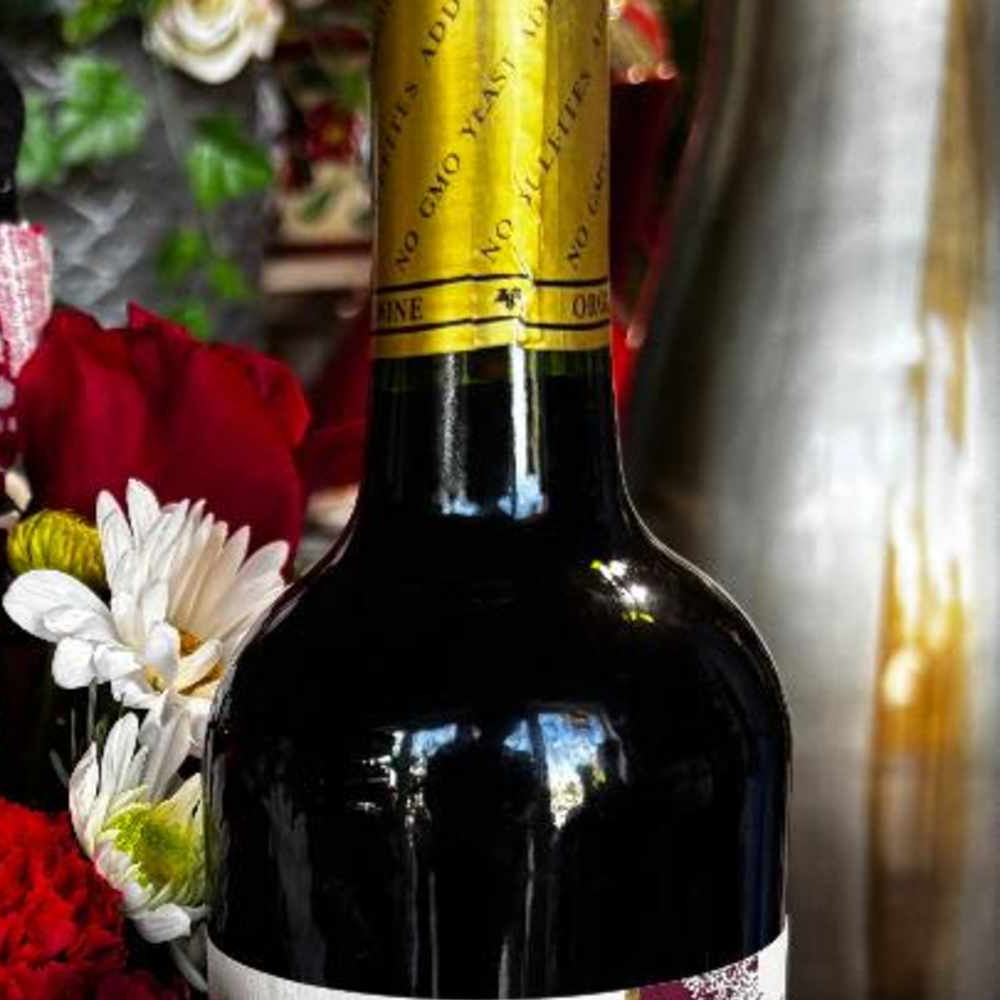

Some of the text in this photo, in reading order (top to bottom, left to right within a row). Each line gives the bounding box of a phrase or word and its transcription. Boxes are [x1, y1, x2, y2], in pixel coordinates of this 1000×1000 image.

[396, 230, 420, 273] NO
[418, 152, 461, 220] GMO
[480, 218, 513, 264] NO
[567, 225, 589, 270] NO
